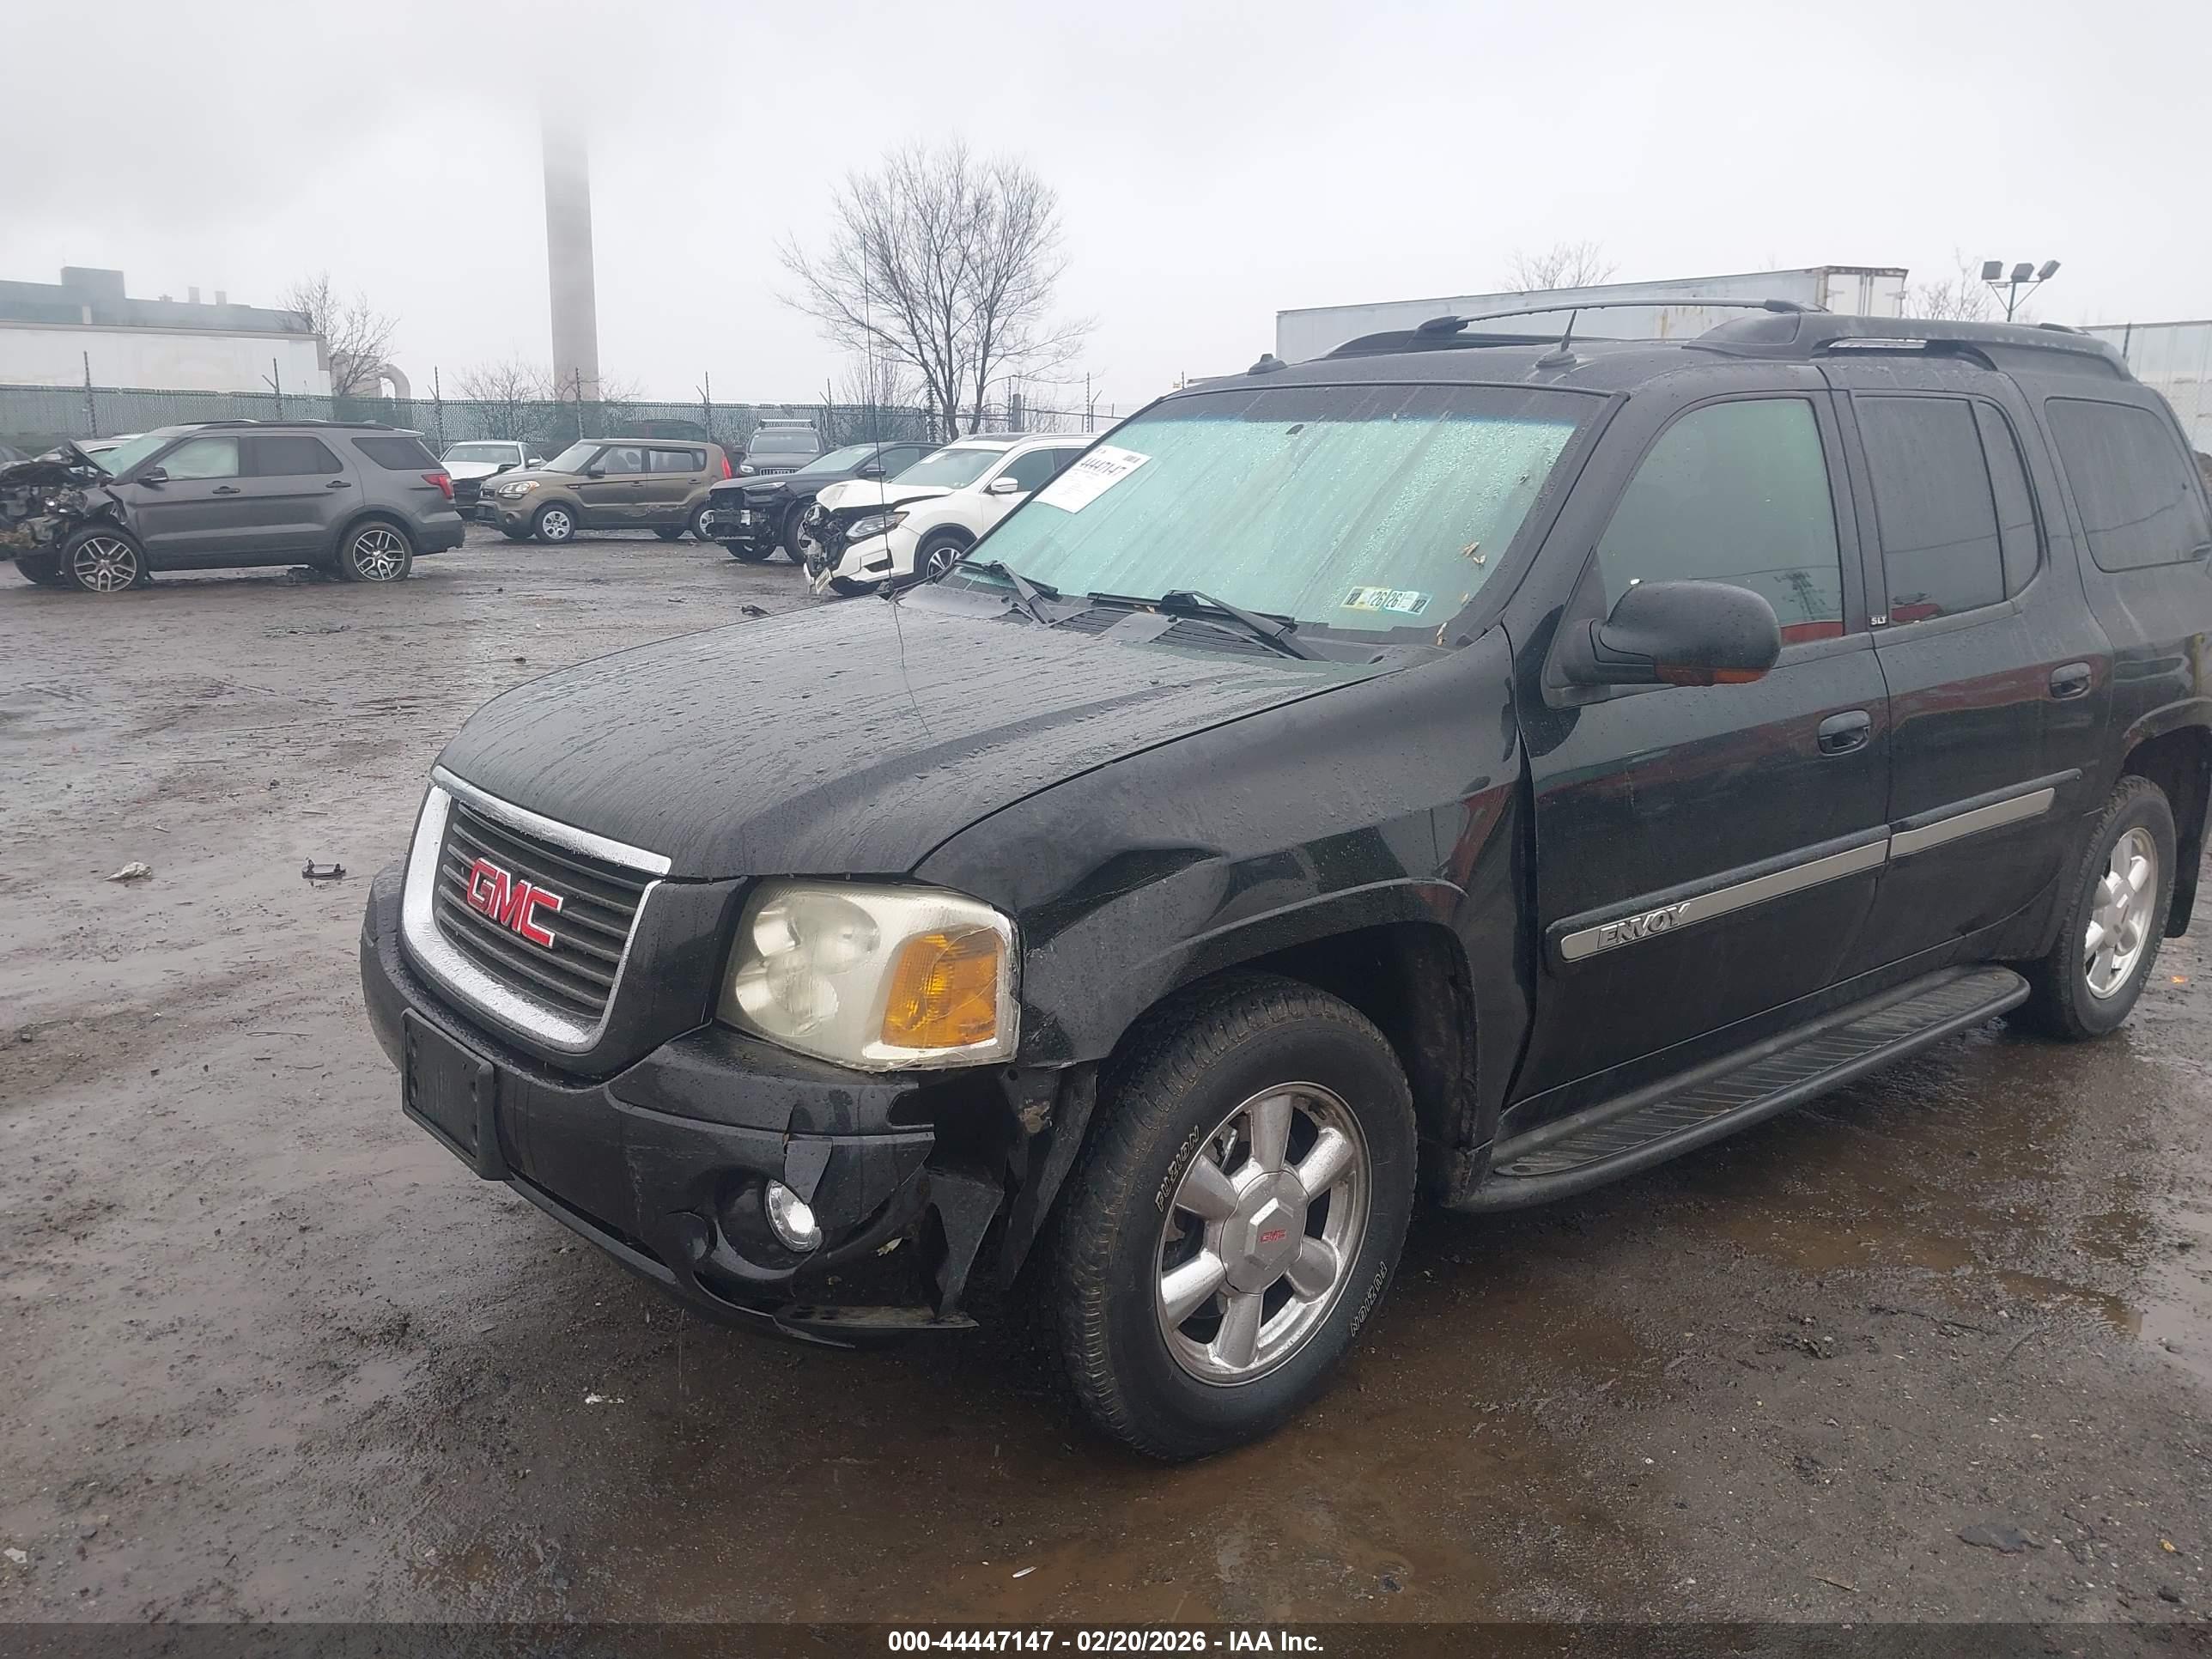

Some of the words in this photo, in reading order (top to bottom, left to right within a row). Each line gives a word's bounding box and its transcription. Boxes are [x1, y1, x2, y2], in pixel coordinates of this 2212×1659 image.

[1370, 591, 1388, 606] 26
[1386, 592, 1403, 608] 26
[1870, 615, 1887, 625] SLT
[466, 857, 564, 950] GMC
[1596, 902, 1692, 950] ENVOY
[1154, 1124, 1200, 1212] FUZION
[1350, 1261, 1388, 1337] FUZION
